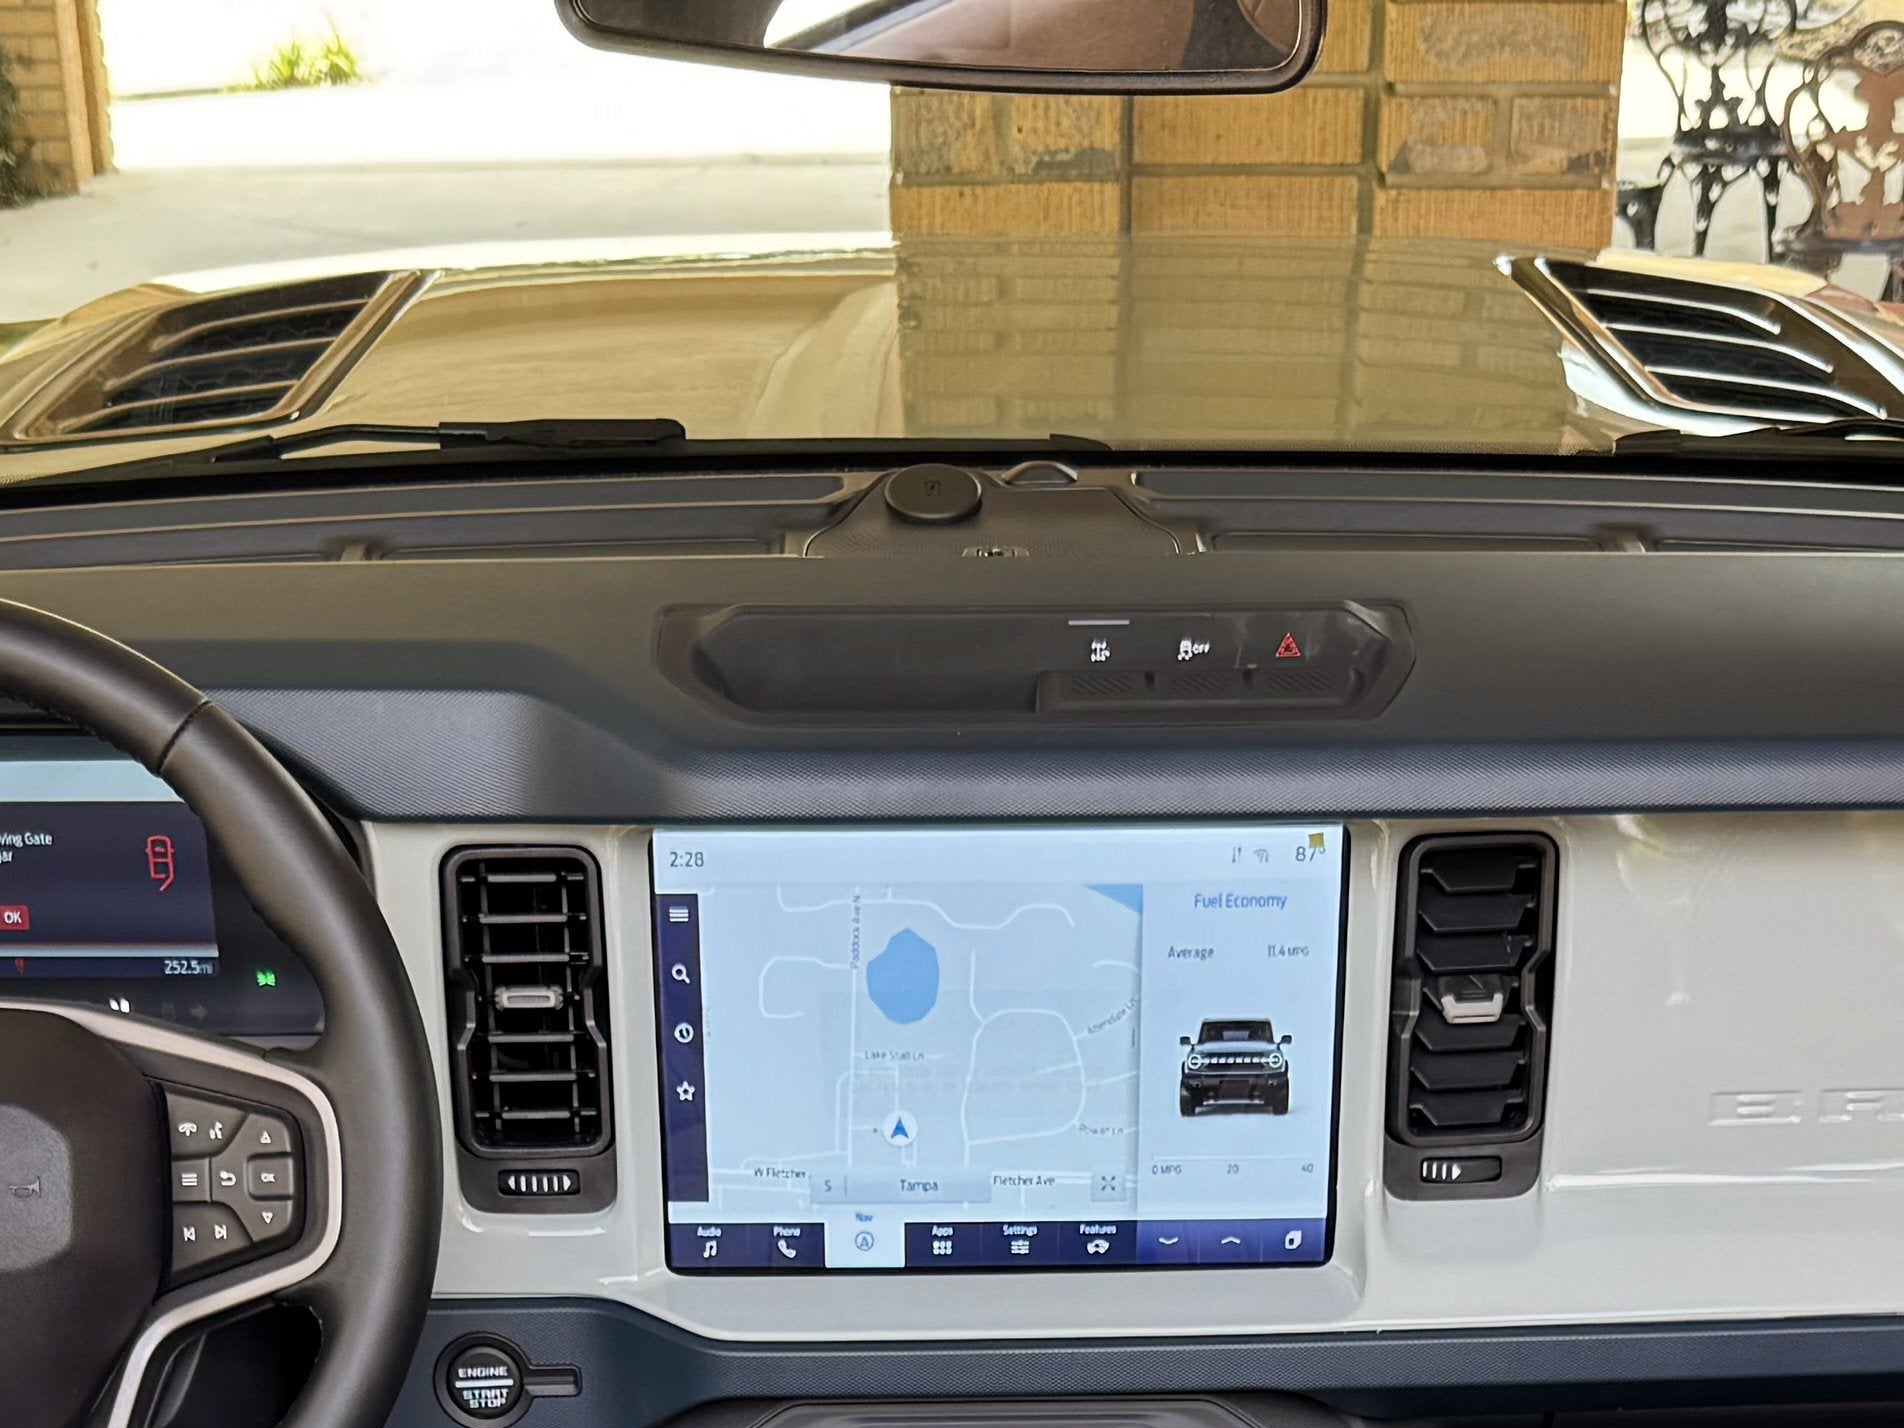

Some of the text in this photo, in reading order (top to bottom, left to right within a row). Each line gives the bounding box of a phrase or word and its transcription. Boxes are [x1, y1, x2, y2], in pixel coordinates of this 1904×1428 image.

[24, 832, 53, 845] Gate
[669, 851, 705, 868] 2:28
[1194, 893, 1288, 910] Fuel Economy
[4, 911, 22, 924] OK
[1168, 945, 1215, 960] Average
[1227, 1164, 1239, 1174] 20
[900, 1179, 938, 1193] Tampa
[993, 1174, 1055, 1187] Fletcher Ave
[697, 1226, 722, 1237] Audio
[773, 1226, 801, 1237] Phone
[931, 1225, 954, 1238] Apps
[1003, 1224, 1038, 1237] Settings
[1079, 1224, 1117, 1236] Features
[457, 1366, 508, 1378] ENGINE
[463, 1388, 509, 1400] START
[469, 1399, 506, 1409] STOP
